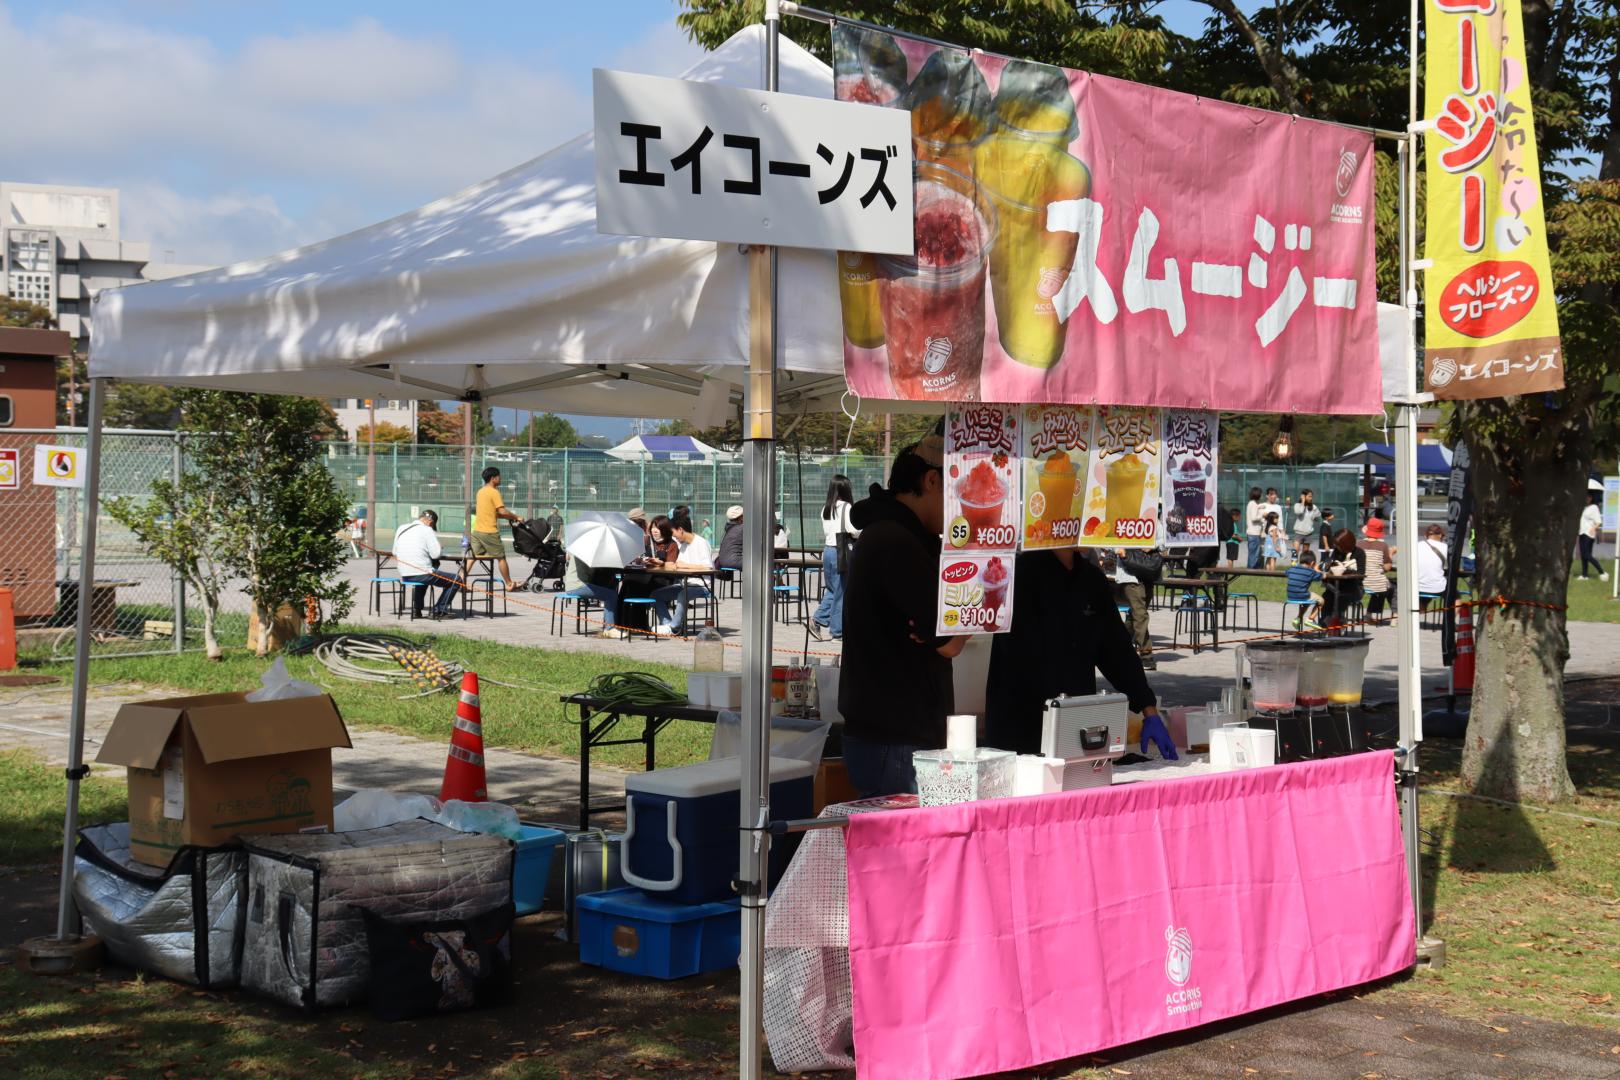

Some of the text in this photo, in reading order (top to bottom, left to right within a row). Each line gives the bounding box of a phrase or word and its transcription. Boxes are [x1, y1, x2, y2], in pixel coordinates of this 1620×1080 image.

[619, 122, 898, 212] エイコーンズ
[1330, 203, 1363, 217] ACORNS
[1046, 197, 1358, 348] スムージー
[1456, 270, 1522, 297] ヘルシー
[1449, 284, 1535, 324] フローズン
[1459, 348, 1560, 382] エイコーンズ
[922, 371, 957, 387] ACORNS
[964, 407, 1004, 429] いちご
[1043, 410, 1080, 433] みかん
[1105, 415, 1153, 437] マンゴー
[953, 425, 1012, 451] スムージー
[1030, 429, 1088, 458] スムージー
[1097, 432, 1158, 460] スムージー
[1167, 435, 1212, 461] スムージー
[952, 525, 967, 539] $5
[976, 526, 1015, 545] ¥600
[1051, 518, 1080, 538] ¥600
[1115, 519, 1154, 538] ¥600
[1186, 516, 1215, 535] ¥650
[944, 564, 975, 580] トッピング
[943, 583, 985, 607] ミルク
[960, 607, 995, 627] ¥100
[1165, 986, 1201, 1006] ACORNS
